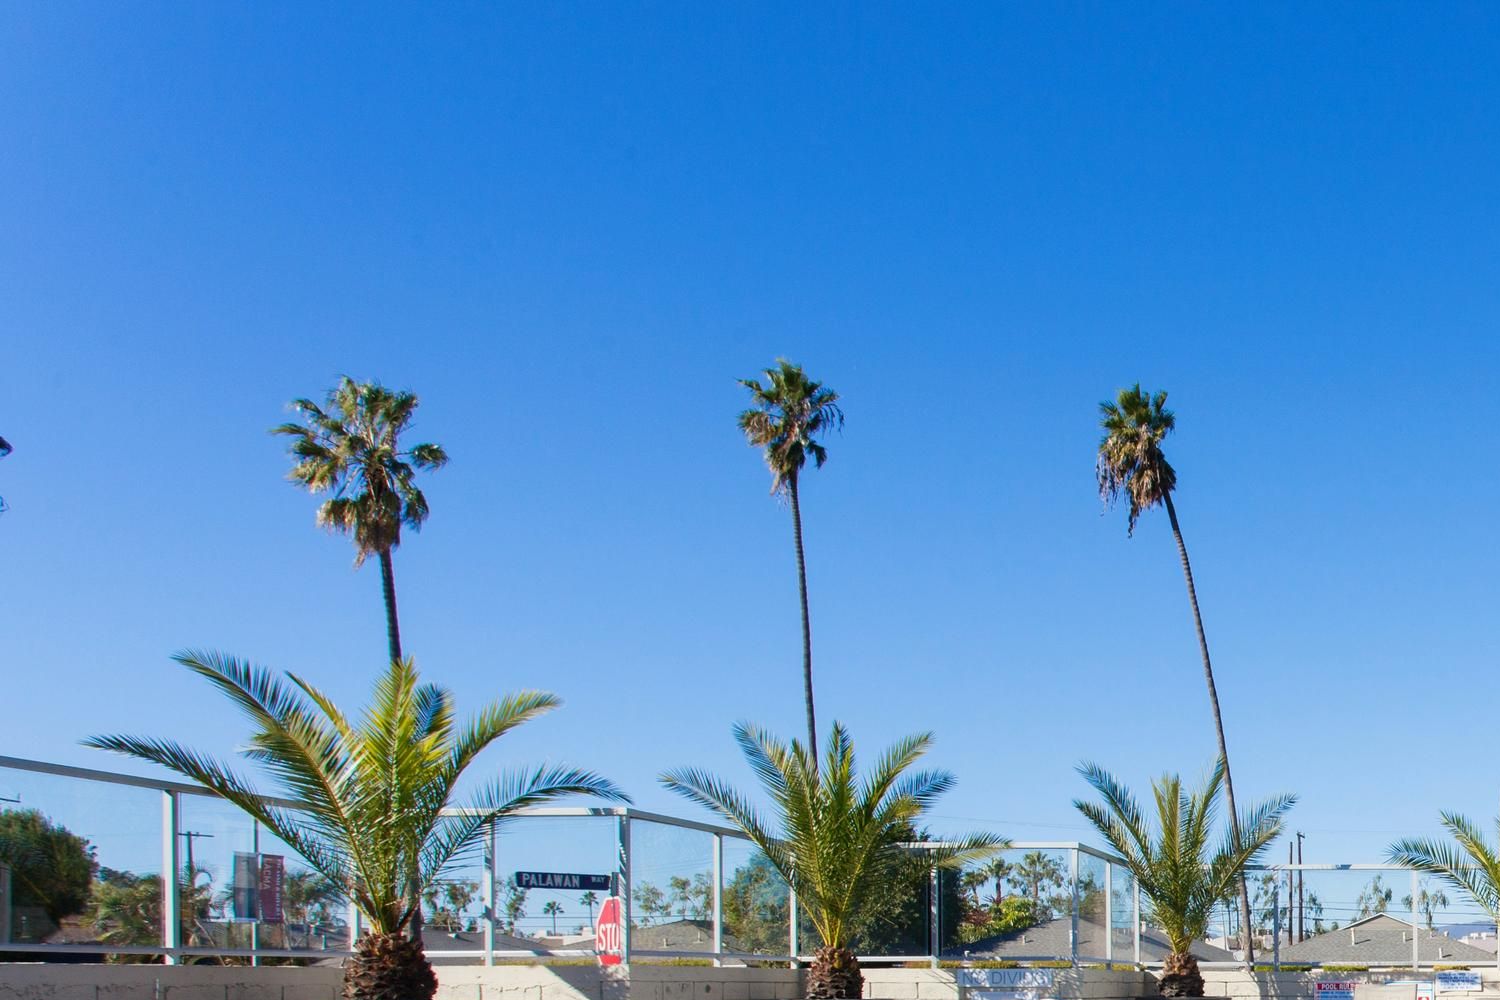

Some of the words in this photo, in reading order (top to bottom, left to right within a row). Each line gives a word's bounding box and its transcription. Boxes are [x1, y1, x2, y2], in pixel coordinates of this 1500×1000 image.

[522, 873, 580, 888] PALAWAN
[599, 923, 620, 951] STO
[962, 971, 986, 985] NO
[991, 971, 1046, 985] DIVING
